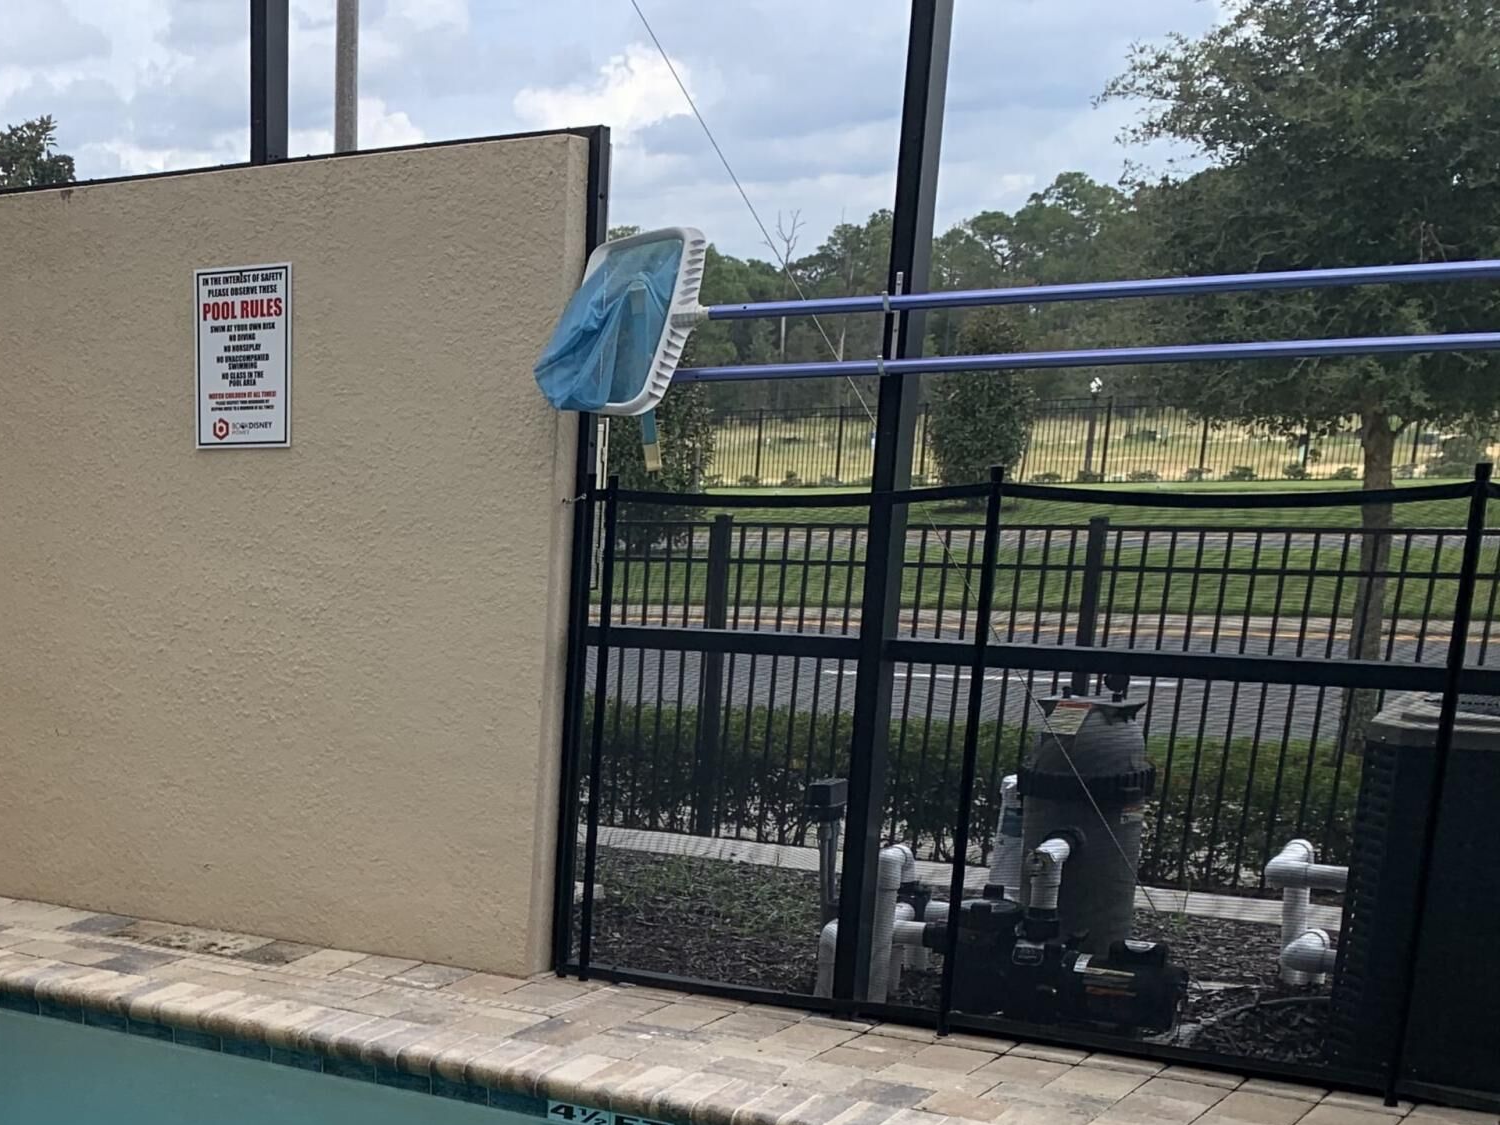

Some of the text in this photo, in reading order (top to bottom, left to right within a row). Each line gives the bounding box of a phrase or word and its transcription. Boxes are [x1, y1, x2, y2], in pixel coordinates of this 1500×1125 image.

[210, 276, 221, 285] THE
[223, 274, 250, 284] INTEREST
[252, 273, 259, 282] OF
[261, 272, 282, 281] SAFETY
[208, 284, 277, 298] PLEASE OBSERVE THESE
[203, 298, 282, 321] POOL RULES
[249, 323, 261, 331] OWN
[263, 322, 275, 330] RISK
[237, 333, 256, 341] DIVING
[232, 344, 261, 352] HORSEPLAY
[225, 354, 269, 363] UNACCOMPANIED
[228, 362, 257, 370] SWIMMING
